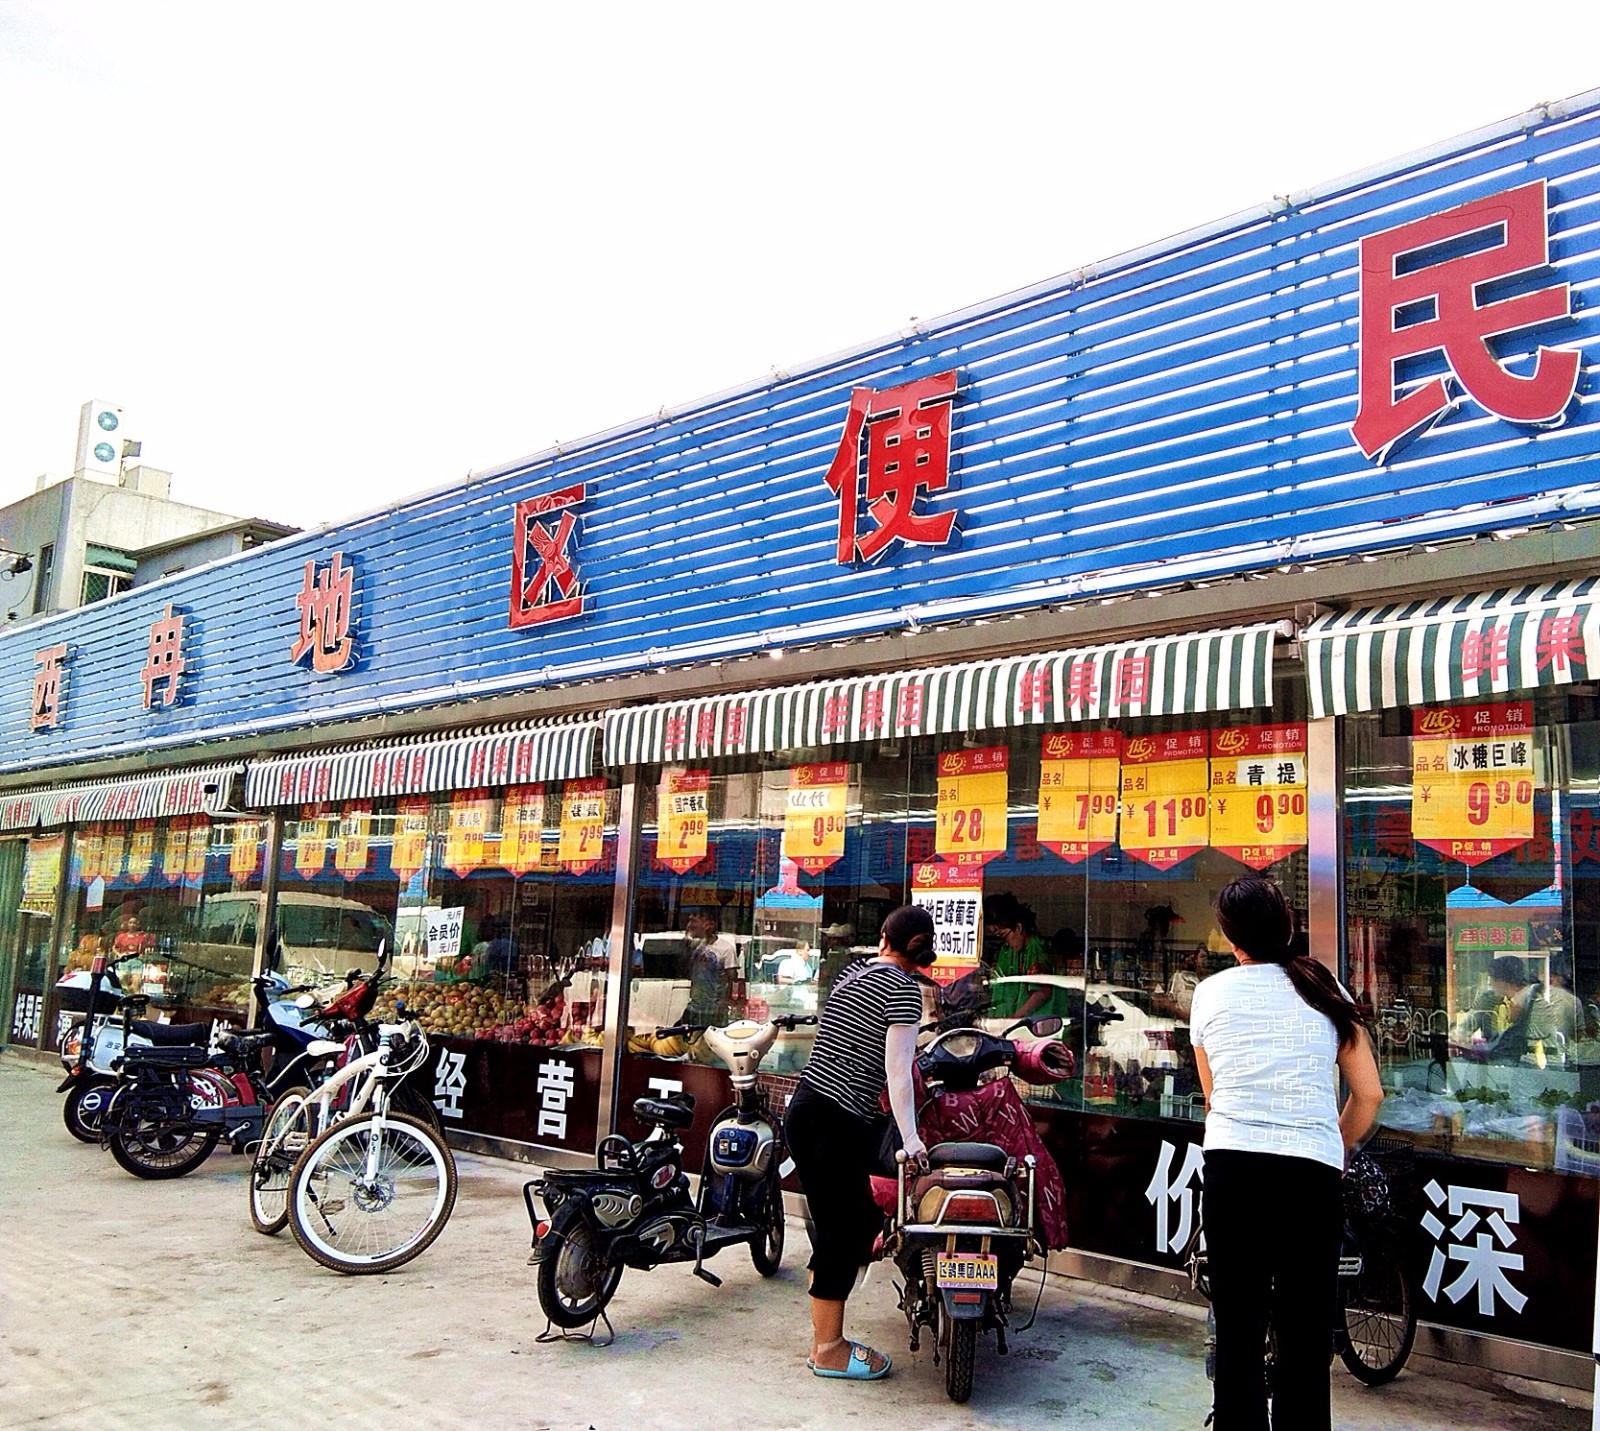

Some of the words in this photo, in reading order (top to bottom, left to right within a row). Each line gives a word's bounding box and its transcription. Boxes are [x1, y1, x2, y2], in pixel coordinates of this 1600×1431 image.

[1461, 613, 1588, 683] 鲜果
[1018, 656, 1150, 715] 鲜果园
[823, 685, 925, 735] 鲜果园
[1474, 708, 1523, 724] 促销
[664, 706, 747, 752] 鲜果园
[1260, 729, 1300, 742] 促销
[1471, 723, 1526, 732] PROMOTION
[1165, 736, 1201, 750] 促销
[1257, 741, 1301, 750] PROMOTION
[974, 751, 1003, 764] 促销
[1163, 748, 1204, 757] PROMOTION
[1416, 755, 1445, 772] 品名
[1454, 741, 1527, 770] 冰糖巨峰
[470, 742, 533, 782] 鲜果园
[972, 762, 1005, 770] PROMOTION
[1042, 772, 1061, 785] 品名
[1213, 770, 1236, 785] 品名
[1247, 763, 1296, 786] 青提
[1123, 776, 1144, 792] 品名
[940, 788, 956, 801] 品名
[1421, 786, 1431, 803] ¥
[951, 808, 982, 843] 28
[429, 922, 460, 941] 会员价
[1420, 1178, 1529, 1317] 深
